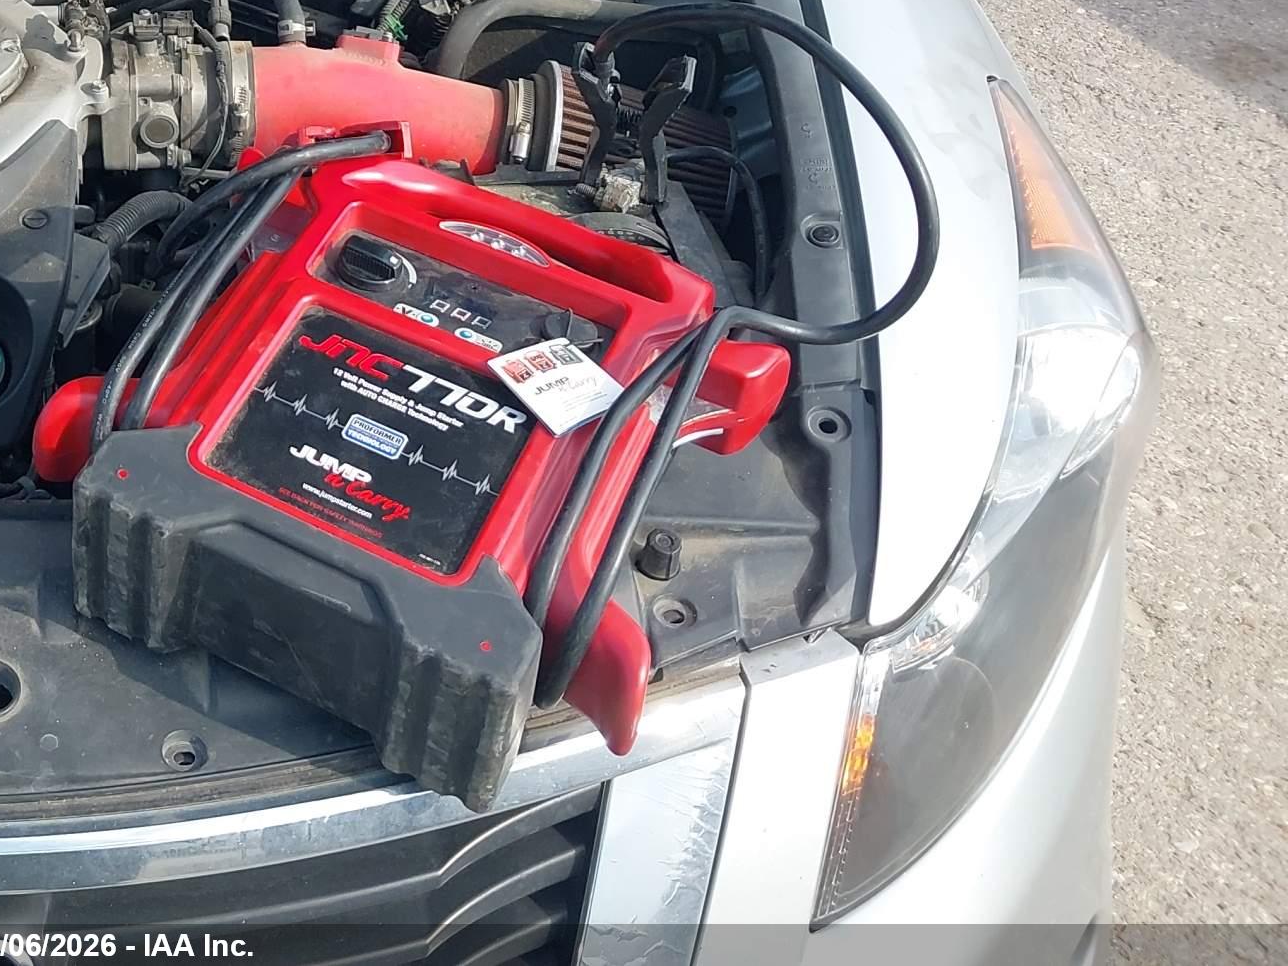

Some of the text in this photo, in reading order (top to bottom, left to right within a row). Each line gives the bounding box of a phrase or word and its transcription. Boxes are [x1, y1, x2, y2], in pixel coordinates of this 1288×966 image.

[333, 367, 343, 377] 12
[343, 371, 359, 383] Volt
[358, 378, 382, 393] Power
[382, 388, 408, 405] Supply
[414, 403, 437, 417] Jump
[436, 412, 464, 427] Starter
[340, 380, 449, 431] with AUTO CHARGE Technology
[353, 419, 402, 444] PROFORMER
[289, 444, 372, 483] JUMP
[302, 482, 372, 520] www.jumpstarter.com
